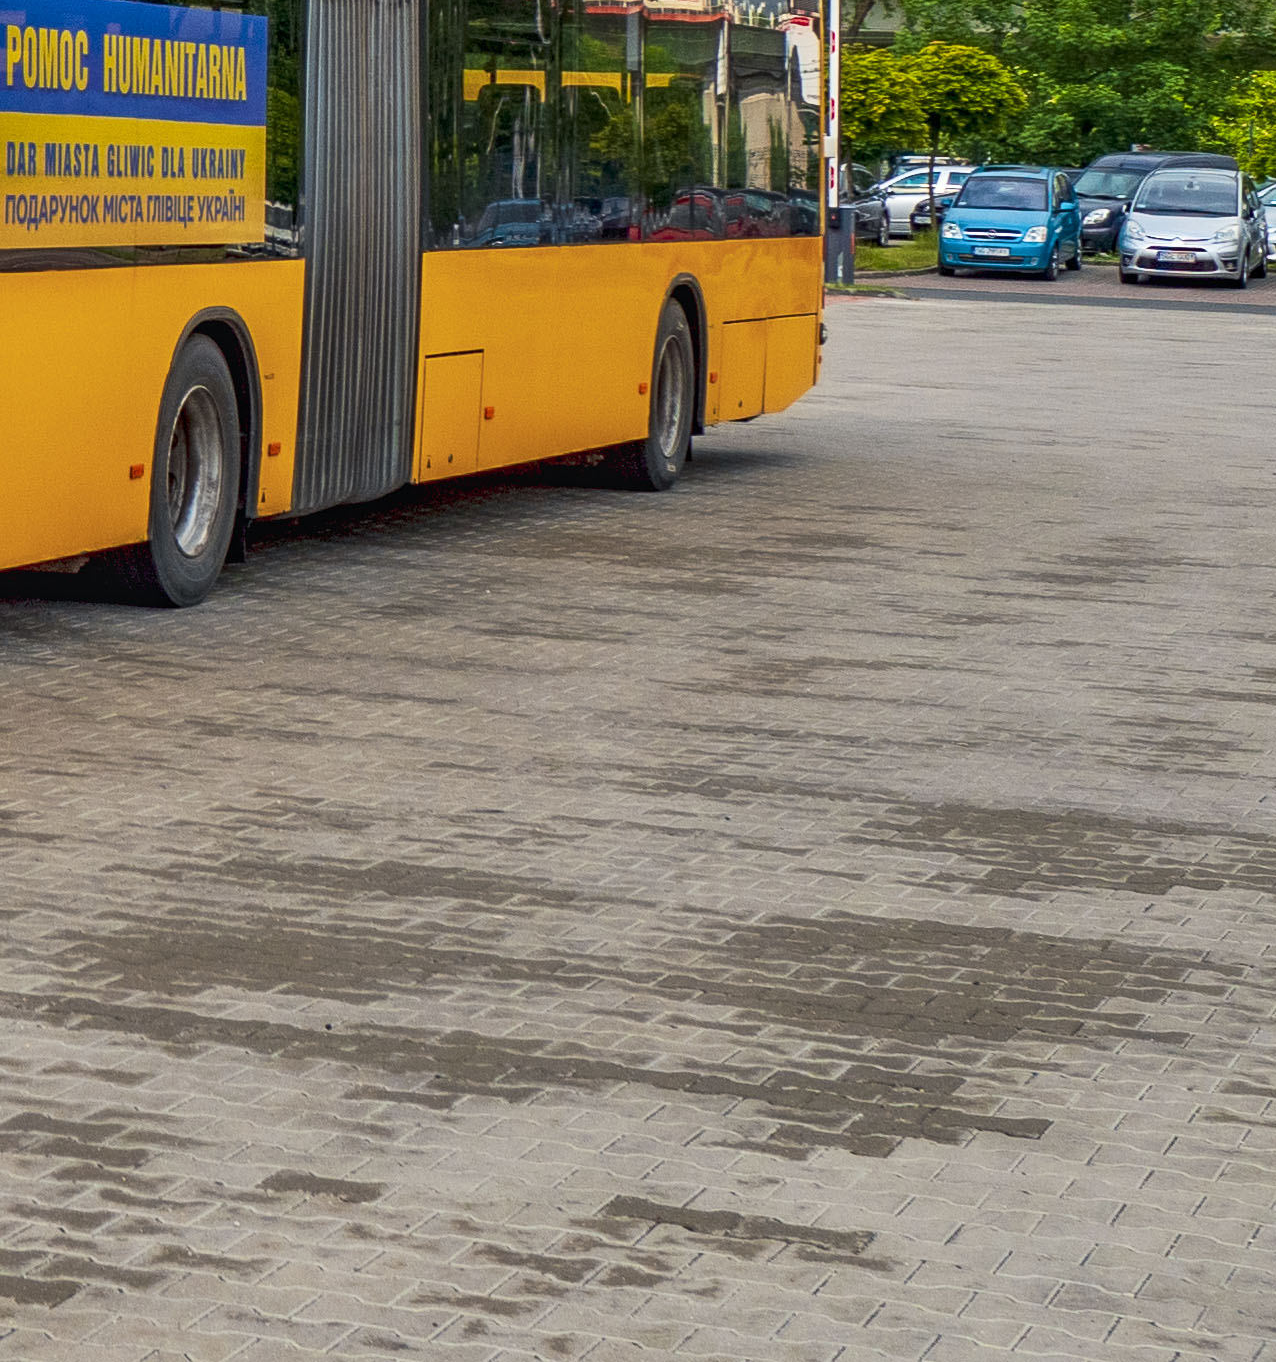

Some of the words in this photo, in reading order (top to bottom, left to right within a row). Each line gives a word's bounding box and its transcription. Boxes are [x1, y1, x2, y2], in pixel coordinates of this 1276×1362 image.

[5, 24, 89, 92] POMOC
[103, 34, 247, 102] HUMANITARNA
[5, 141, 37, 177] DAR
[44, 142, 100, 178] MIASTA
[107, 143, 154, 179] GLIWIC
[161, 146, 185, 179] DLA
[191, 147, 246, 180] UKRAINY
[4, 194, 100, 230] ПОДАРУНОК
[102, 194, 144, 223] МІСТА
[146, 194, 195, 228] ГЛІВІЦЕ
[197, 188, 245, 223] УКРАЇНІ
